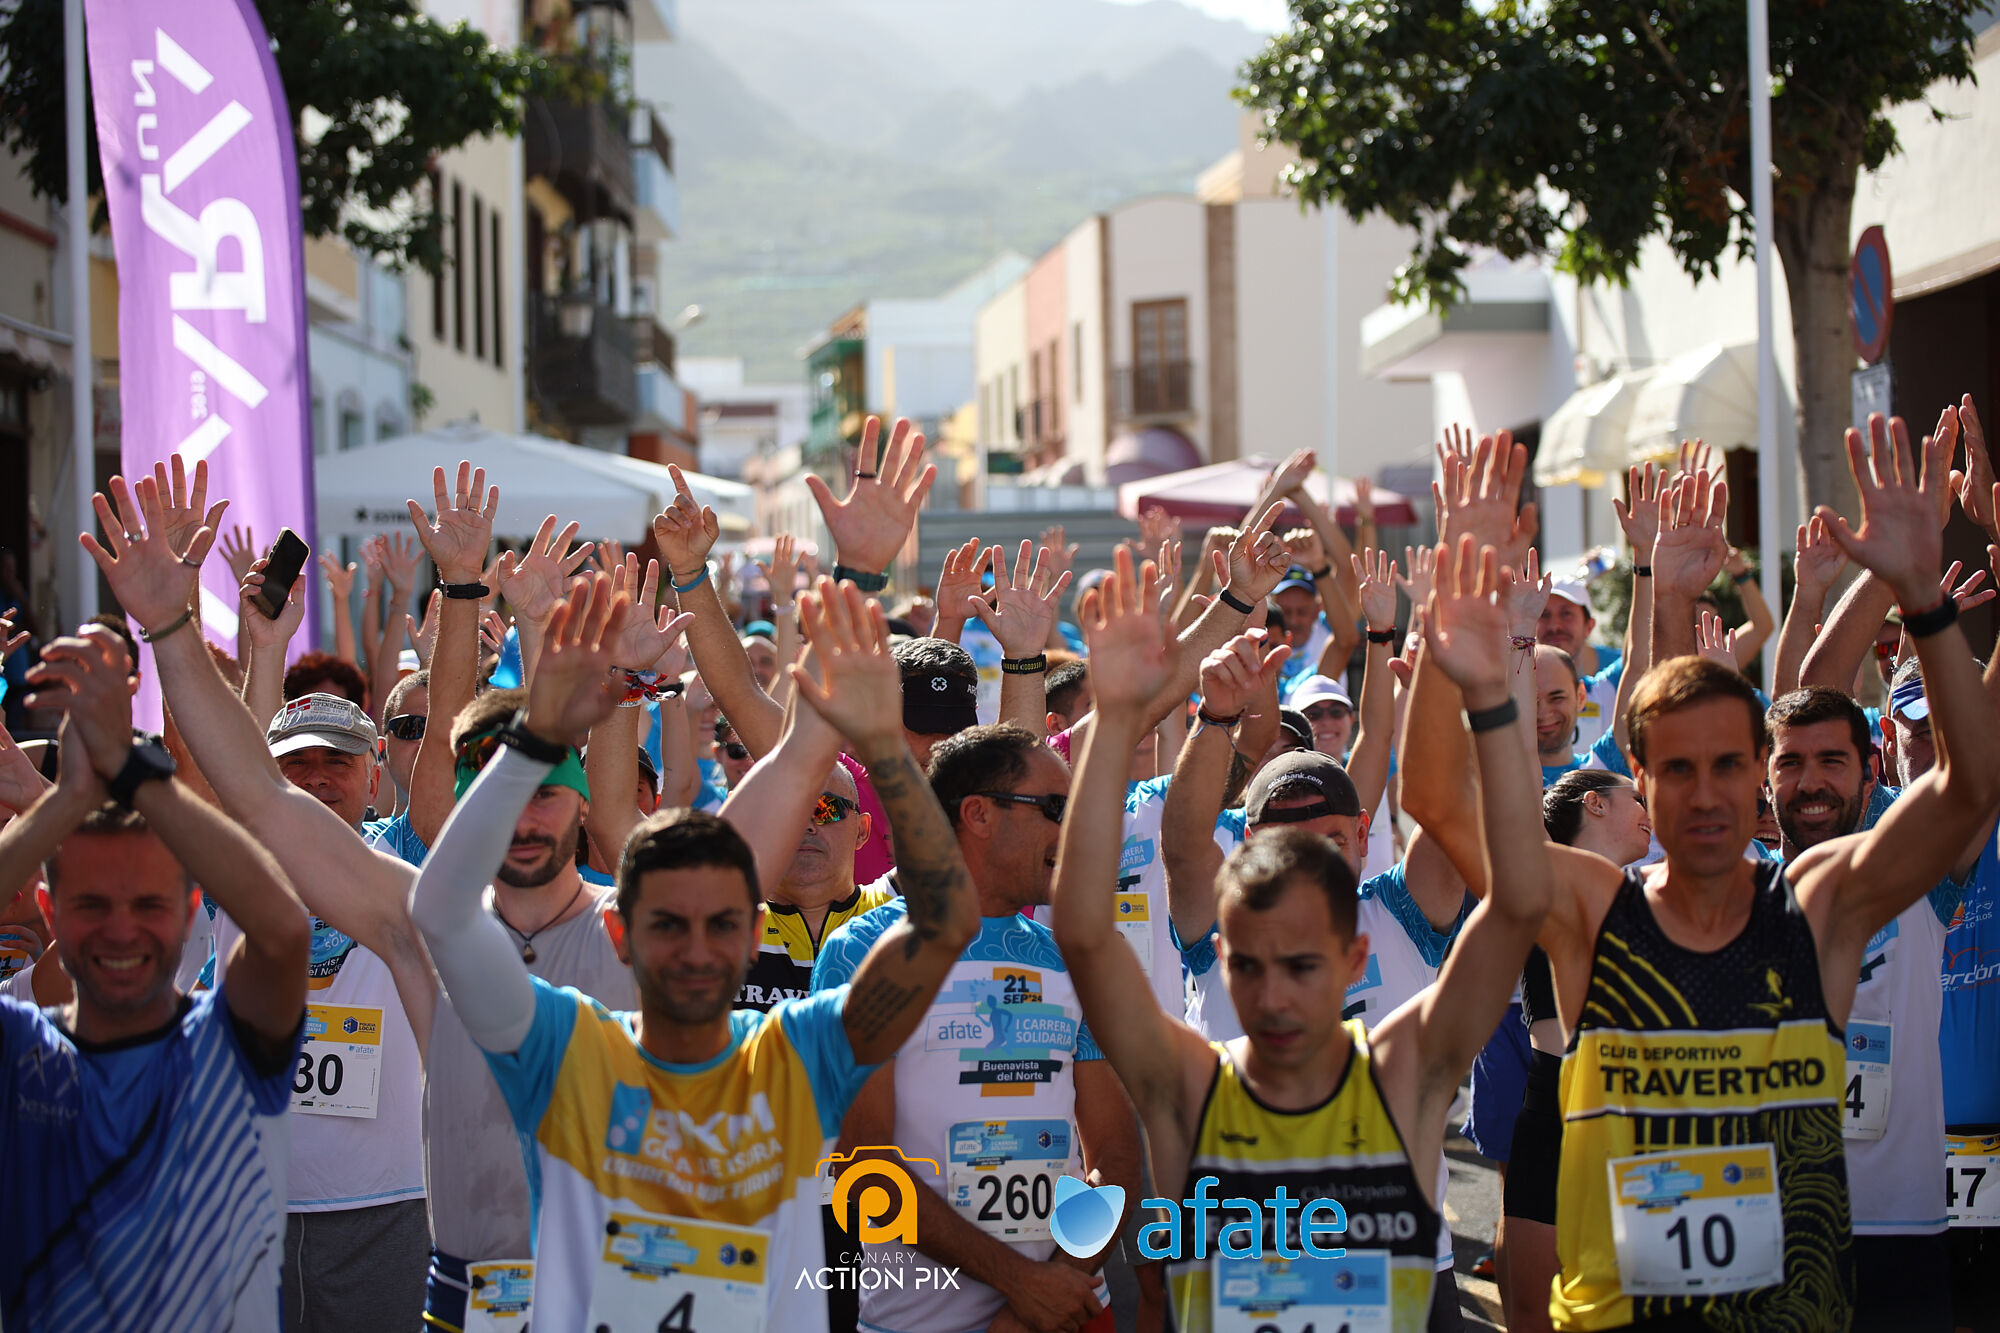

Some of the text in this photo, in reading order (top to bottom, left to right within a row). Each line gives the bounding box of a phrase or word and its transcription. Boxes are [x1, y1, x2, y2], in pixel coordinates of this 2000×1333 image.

[1003, 974, 1030, 993] 21
[938, 1020, 983, 1041] afate
[1022, 1018, 1072, 1035] CARRERA
[1015, 1031, 1073, 1047] SOLIDARIA
[356, 1045, 375, 1055] afate
[1599, 1044, 1742, 1062] CLUB DEPORTIVO
[982, 1060, 1040, 1072] Buenavista
[997, 1071, 1044, 1082] del Norte
[1599, 1056, 1826, 1097] TRAVERTORO
[956, 1185, 970, 1199] 5
[977, 1173, 1053, 1221] 260
[1665, 1212, 1736, 1271] 10
